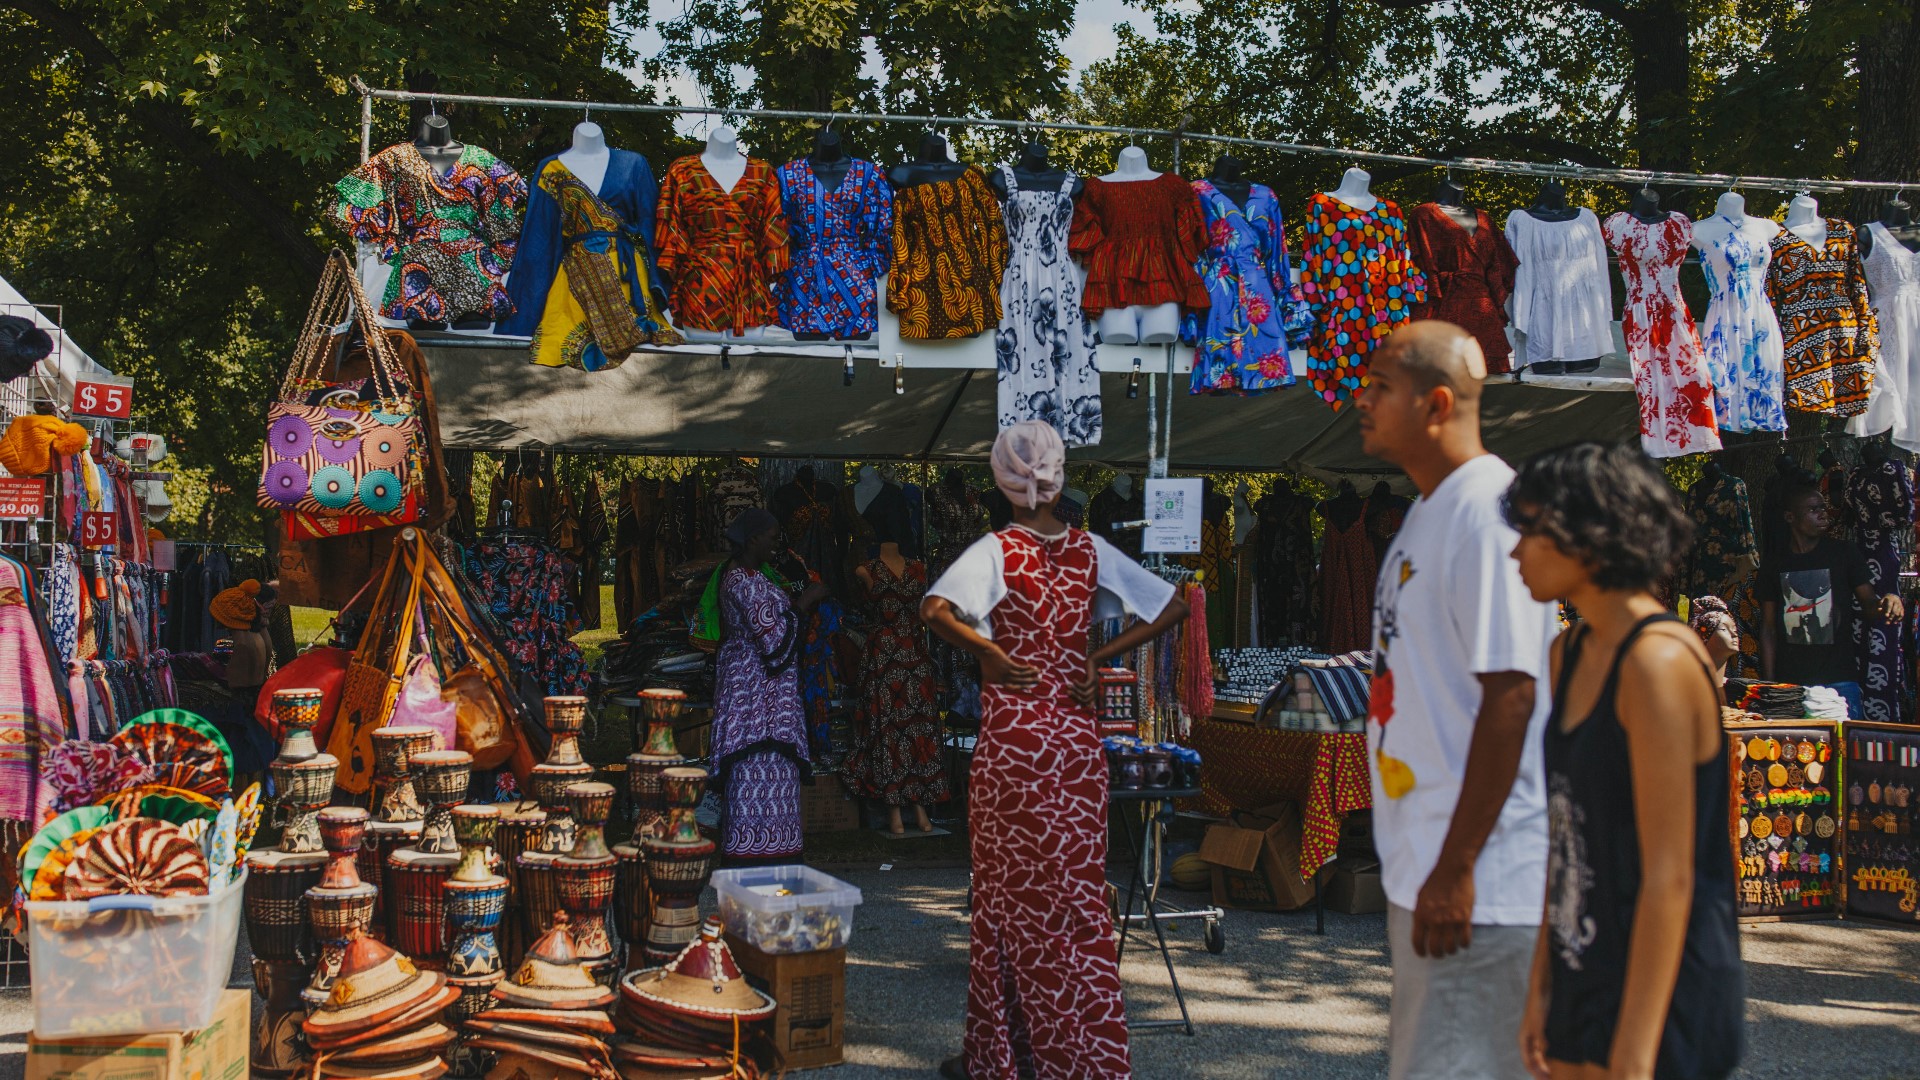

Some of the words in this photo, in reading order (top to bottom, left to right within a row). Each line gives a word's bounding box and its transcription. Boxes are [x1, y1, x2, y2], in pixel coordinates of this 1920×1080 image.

[80, 384, 97, 413] $
[105, 389, 123, 413] 5
[86, 514, 97, 542] $
[101, 516, 112, 540] 5
